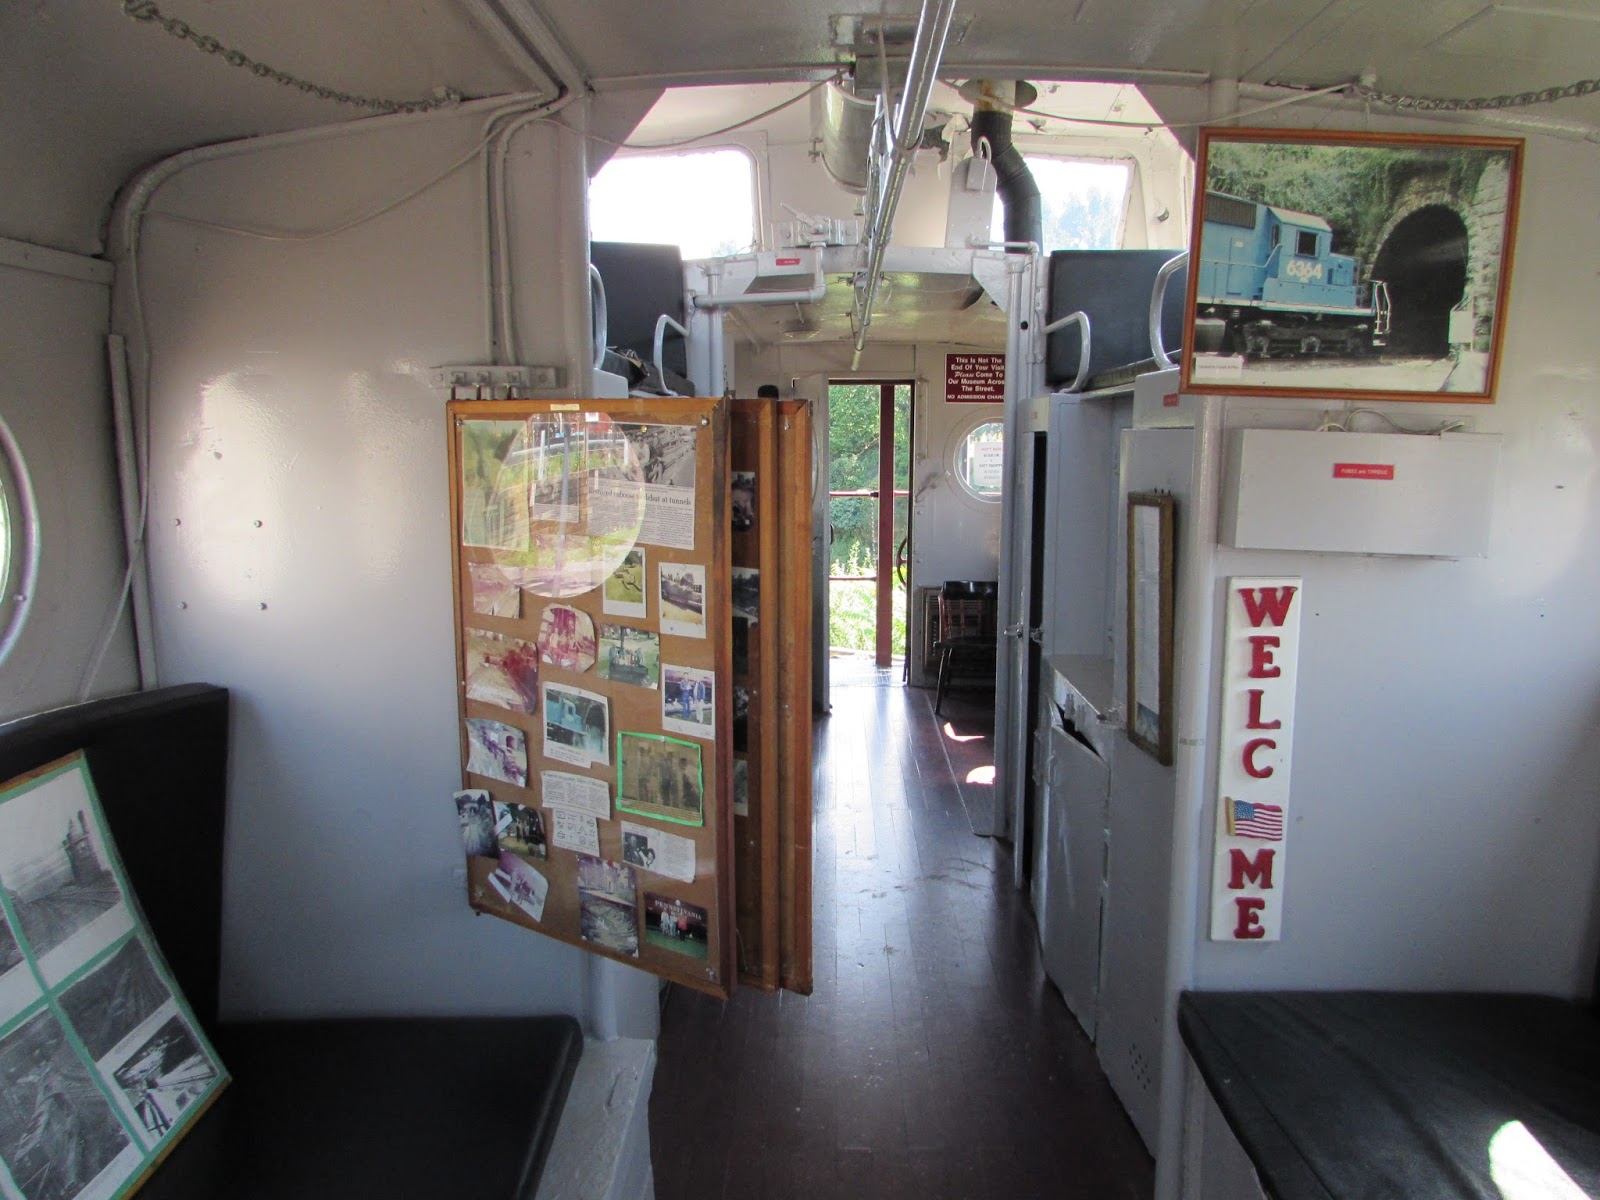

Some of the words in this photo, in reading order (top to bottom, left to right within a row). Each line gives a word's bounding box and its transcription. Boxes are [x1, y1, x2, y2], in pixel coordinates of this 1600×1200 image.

[1286, 258, 1323, 280] 6364
[669, 497, 692, 505] tunnels
[654, 900, 702, 920] PENNSYLVANIA
